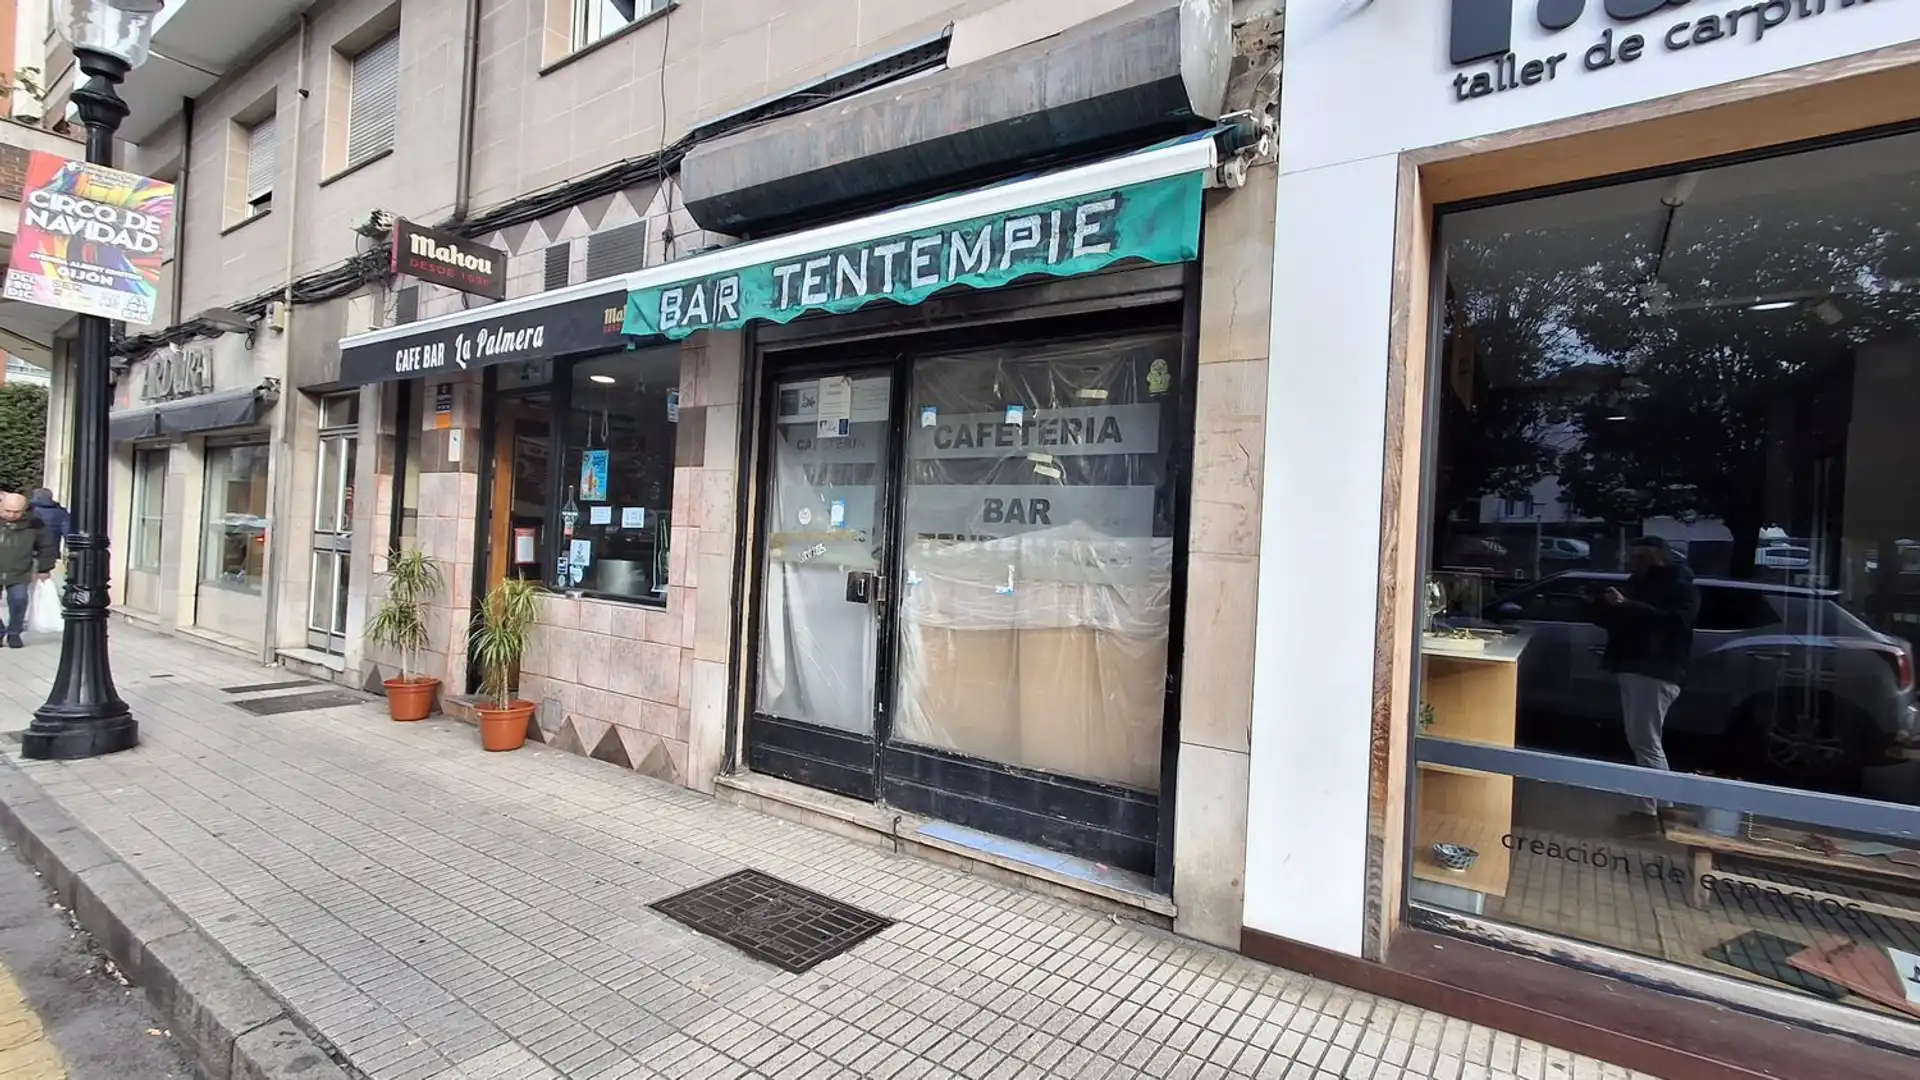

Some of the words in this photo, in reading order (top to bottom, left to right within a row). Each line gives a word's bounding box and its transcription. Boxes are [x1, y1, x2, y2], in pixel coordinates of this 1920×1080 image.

[1453, 52, 1567, 101] taller
[1584, 28, 1645, 71] de
[25, 208, 159, 253] NAVIDAD
[28, 190, 118, 223] CIRCO
[123, 210, 162, 235] DE
[409, 233, 493, 275] Mahou
[409, 258, 456, 278] DESDE
[659, 276, 739, 331] BAR
[773, 198, 1116, 310] TENTEMPIE
[395, 346, 421, 372] CAFE
[423, 342, 445, 369] BAR
[455, 333, 471, 369] La
[476, 324, 544, 358] Palmera
[933, 415, 1123, 450] CAFETERIA
[983, 498, 1052, 525] BAR
[1501, 834, 1630, 874] creación
[1645, 856, 1686, 885] de
[1700, 874, 1861, 919] espacios
